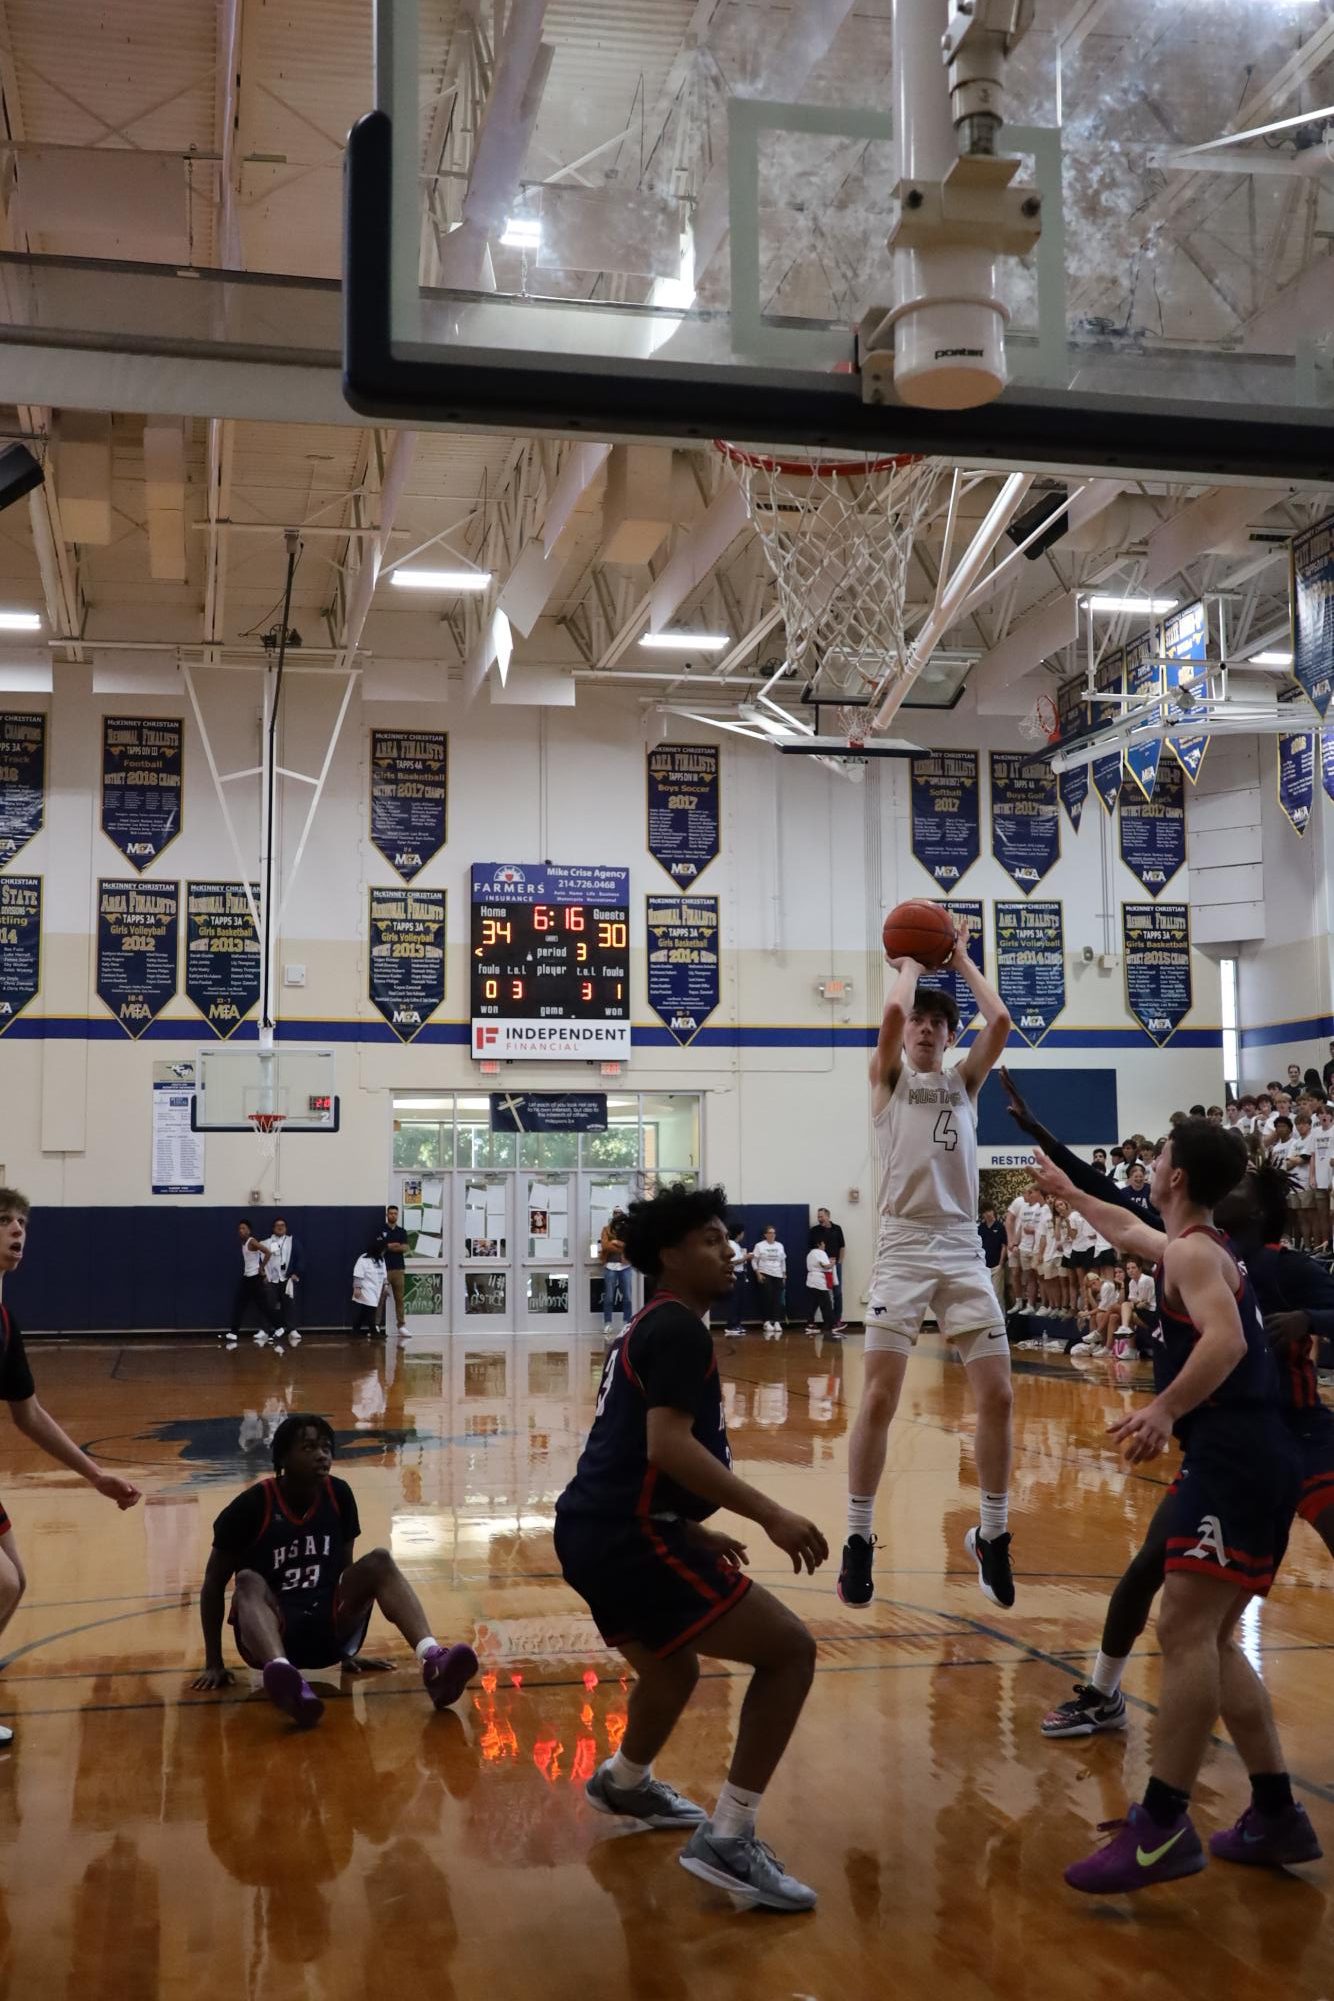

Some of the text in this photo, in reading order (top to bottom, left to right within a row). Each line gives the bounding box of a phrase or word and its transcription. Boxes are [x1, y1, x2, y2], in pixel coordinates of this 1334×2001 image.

[935, 348, 984, 359] porter
[401, 742, 443, 760] FINALISTS
[124, 760, 162, 768] Football
[675, 754, 716, 772] FINALISTS
[398, 772, 444, 781] Basketball
[397, 783, 424, 797] 2017
[668, 796, 698, 809] 2017
[935, 799, 959, 811] 2017
[547, 868, 626, 880] Mike Crise Agency
[474, 883, 545, 893] FARMERS
[558, 880, 615, 888] 214.726.0468
[2, 885, 37, 905] STATE
[481, 907, 506, 917] Home
[594, 909, 625, 920] Guests
[123, 915, 155, 924] TAPPS 3A
[211, 916, 242, 925] TAPPS 3A
[534, 906, 584, 931] 6:16
[999, 911, 1059, 927] AREA FINALISTS
[111, 925, 165, 936] Girls Volleyball
[199, 927, 252, 937] Girls Basketball
[393, 922, 423, 931] TAPPS 3A
[482, 920, 511, 945] 34
[382, 933, 433, 943] Girls Volleyball
[598, 924, 626, 948] 30
[690, 929, 698, 937] 3A
[1143, 931, 1170, 939] TAPPS 3A
[122, 936, 155, 951] 2012
[210, 938, 244, 952] 2013
[658, 939, 673, 947] Girls
[1021, 940, 1060, 948] Volleyball
[392, 943, 425, 957] 2013
[537, 947, 567, 959] period
[577, 943, 587, 961] 3
[669, 949, 699, 963] 2014
[1017, 951, 1043, 965] 2014
[1144, 951, 1170, 964] 2015
[479, 964, 566, 976] fouls player
[603, 967, 624, 977] fouls
[485, 980, 523, 999] 0 3
[582, 983, 621, 1000] 3 1
[481, 1006, 622, 1016] won game won
[506, 1028, 626, 1040] INDEPENDENT
[506, 1043, 579, 1051] FINANCIAL
[321, 1112, 329, 1122] 2
[933, 1111, 958, 1151] 4
[1183, 1514, 1231, 1568] A
[273, 1535, 331, 1569] HSAI
[282, 1564, 320, 1590] 33
